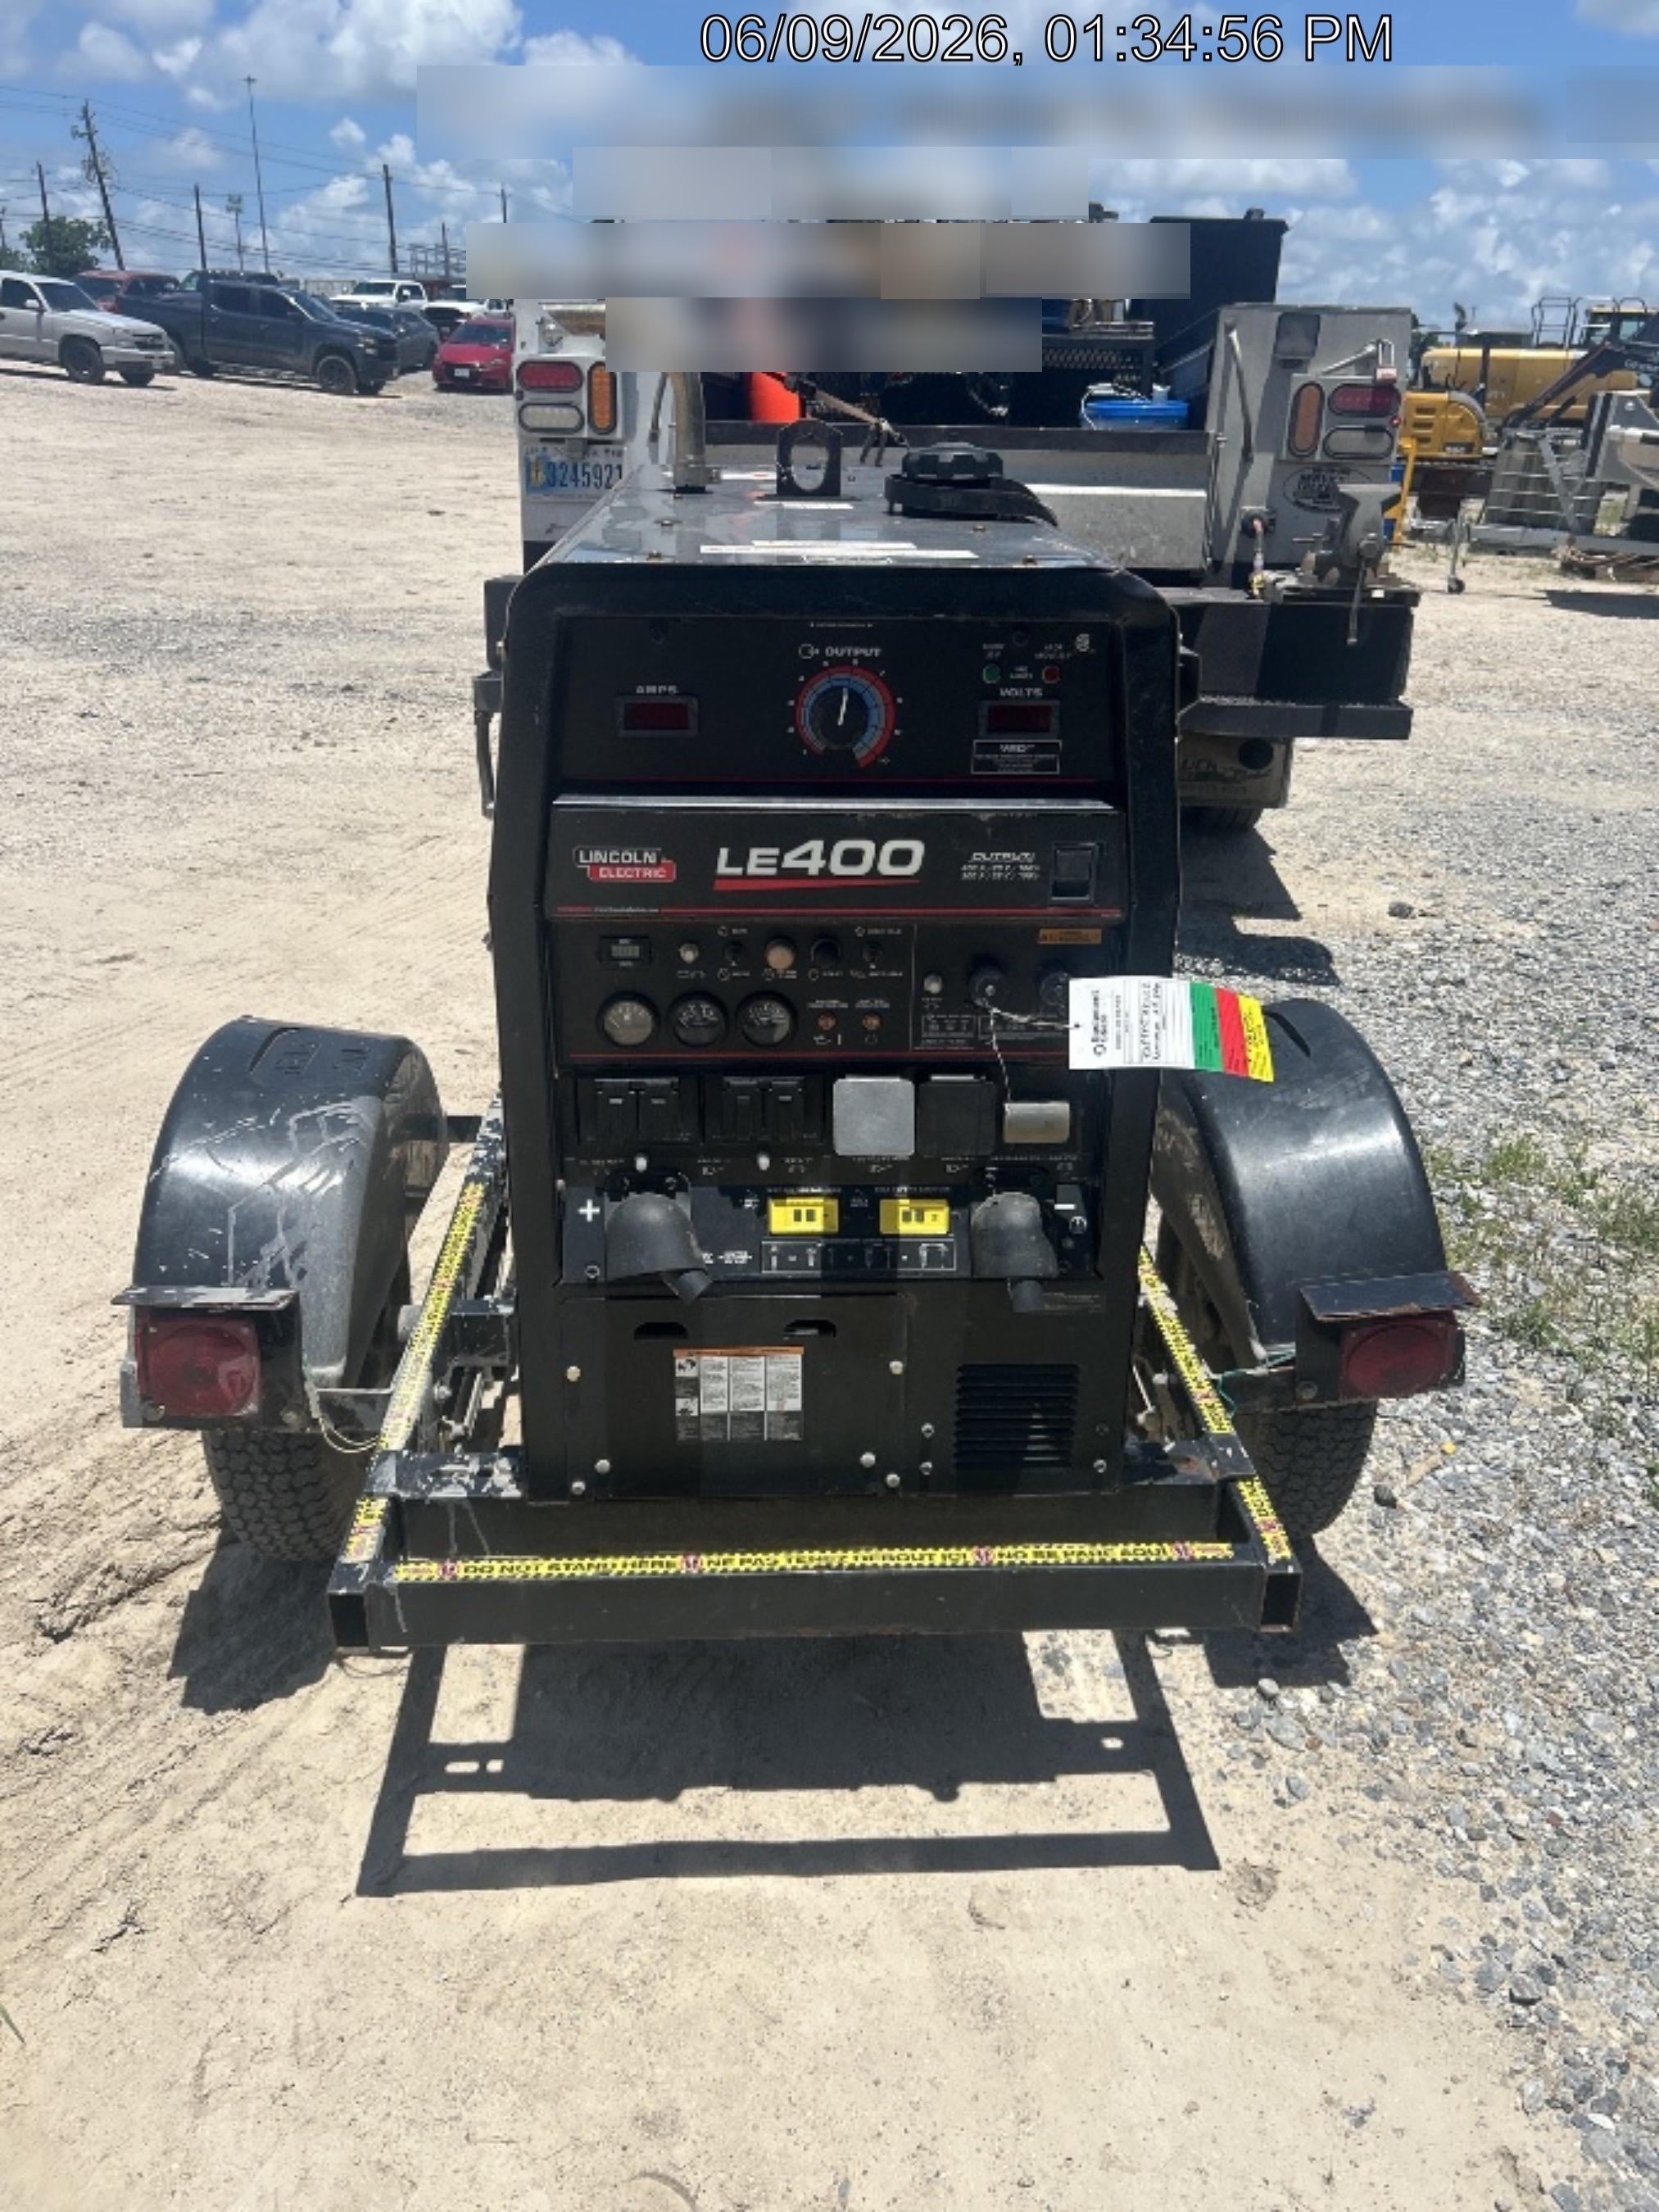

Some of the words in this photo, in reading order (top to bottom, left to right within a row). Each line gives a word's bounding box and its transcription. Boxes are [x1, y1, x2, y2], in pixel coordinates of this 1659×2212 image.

[824, 646, 882, 658] OUTPUT
[635, 684, 679, 695] AMPS
[578, 850, 657, 864] LINCOLN
[715, 839, 927, 876] LE400
[598, 867, 668, 880] ELECTRIC
[464, 1565, 494, 1574] DO
[499, 1563, 542, 1573] NOT
[546, 1561, 618, 1572] STAND
